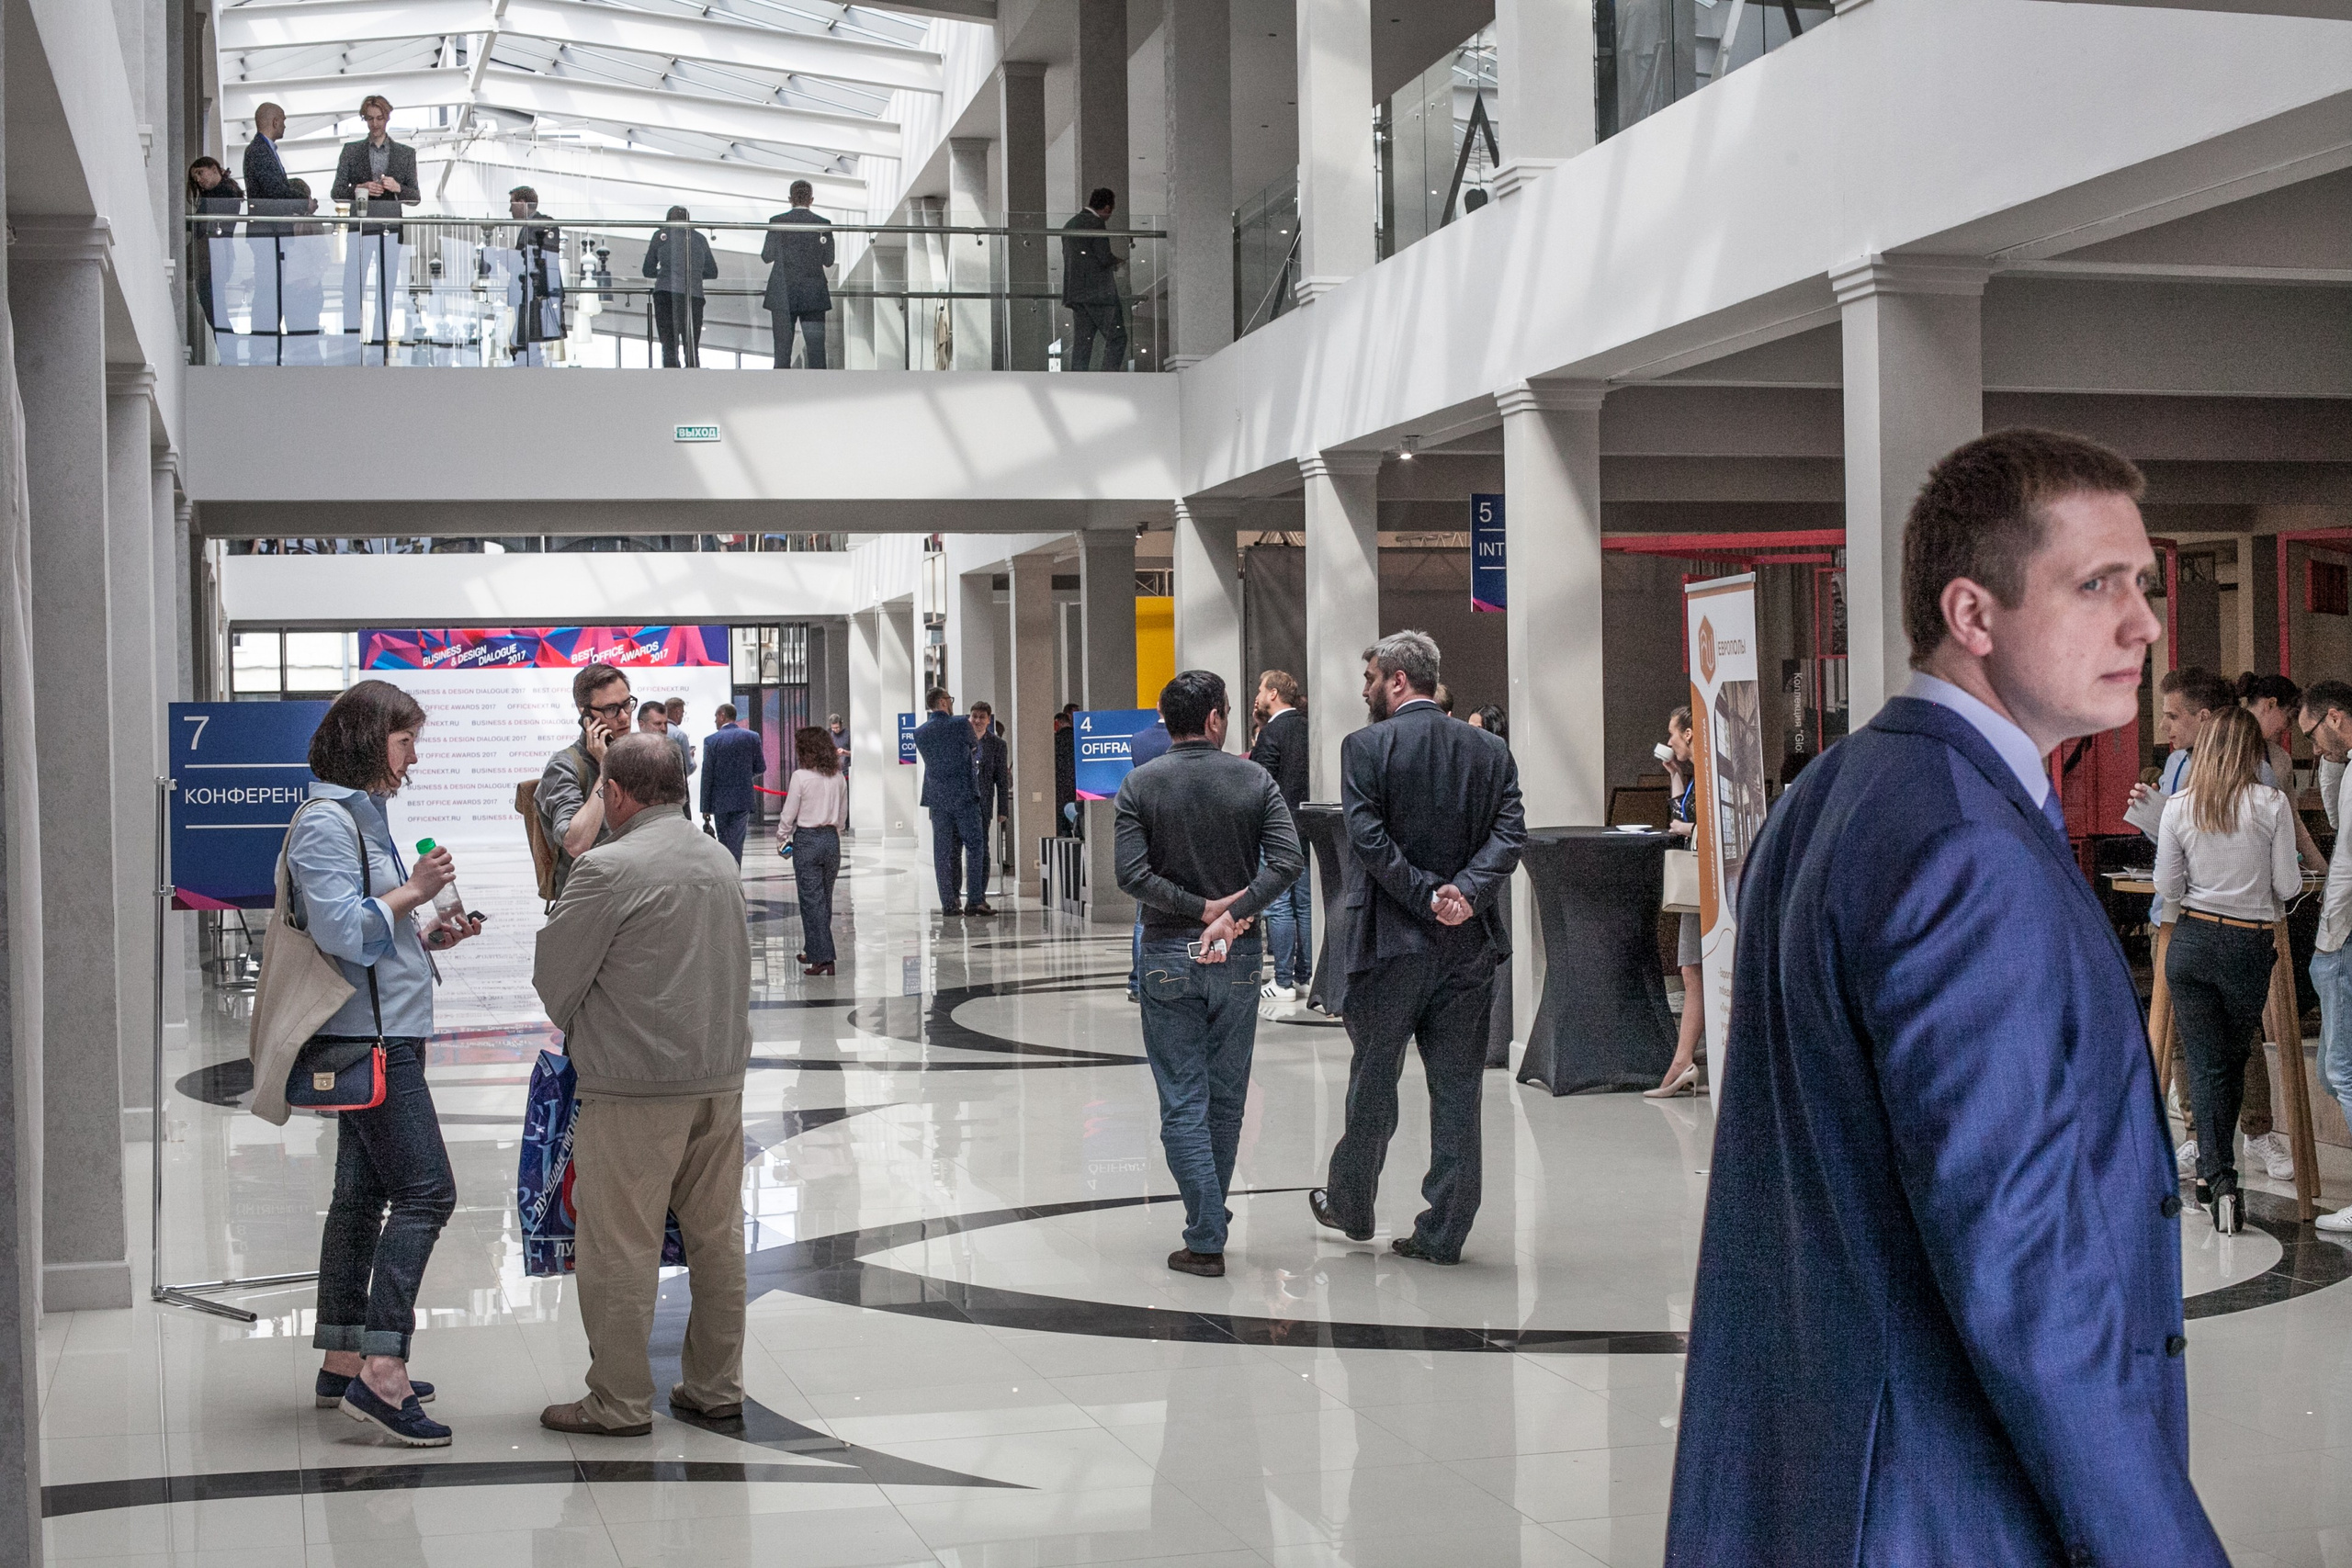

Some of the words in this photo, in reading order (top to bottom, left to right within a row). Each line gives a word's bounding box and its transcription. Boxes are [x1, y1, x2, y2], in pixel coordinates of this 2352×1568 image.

[678, 427, 717, 437] ВЫХОД
[1479, 502, 1492, 523] 5
[1479, 542, 1505, 557] INT
[423, 644, 462, 667] BUSINESS
[450, 657, 458, 667] &
[458, 645, 487, 665] DESIGN
[478, 643, 517, 667] DIALOGUE
[507, 650, 526, 666] 2017
[571, 647, 594, 665] BEST
[591, 644, 624, 664] OFFICE
[619, 641, 660, 664] AWARDS
[650, 649, 669, 664] 2017
[1793, 672, 1804, 728] Коллекция
[901, 716, 906, 726] 1
[1080, 716, 1092, 732] 4
[184, 716, 209, 750] 7
[1794, 729, 1804, 753] "Glo
[1081, 741, 1131, 755] OFIFRA
[533, 1155, 566, 1218] ЛУЧШАЯ
